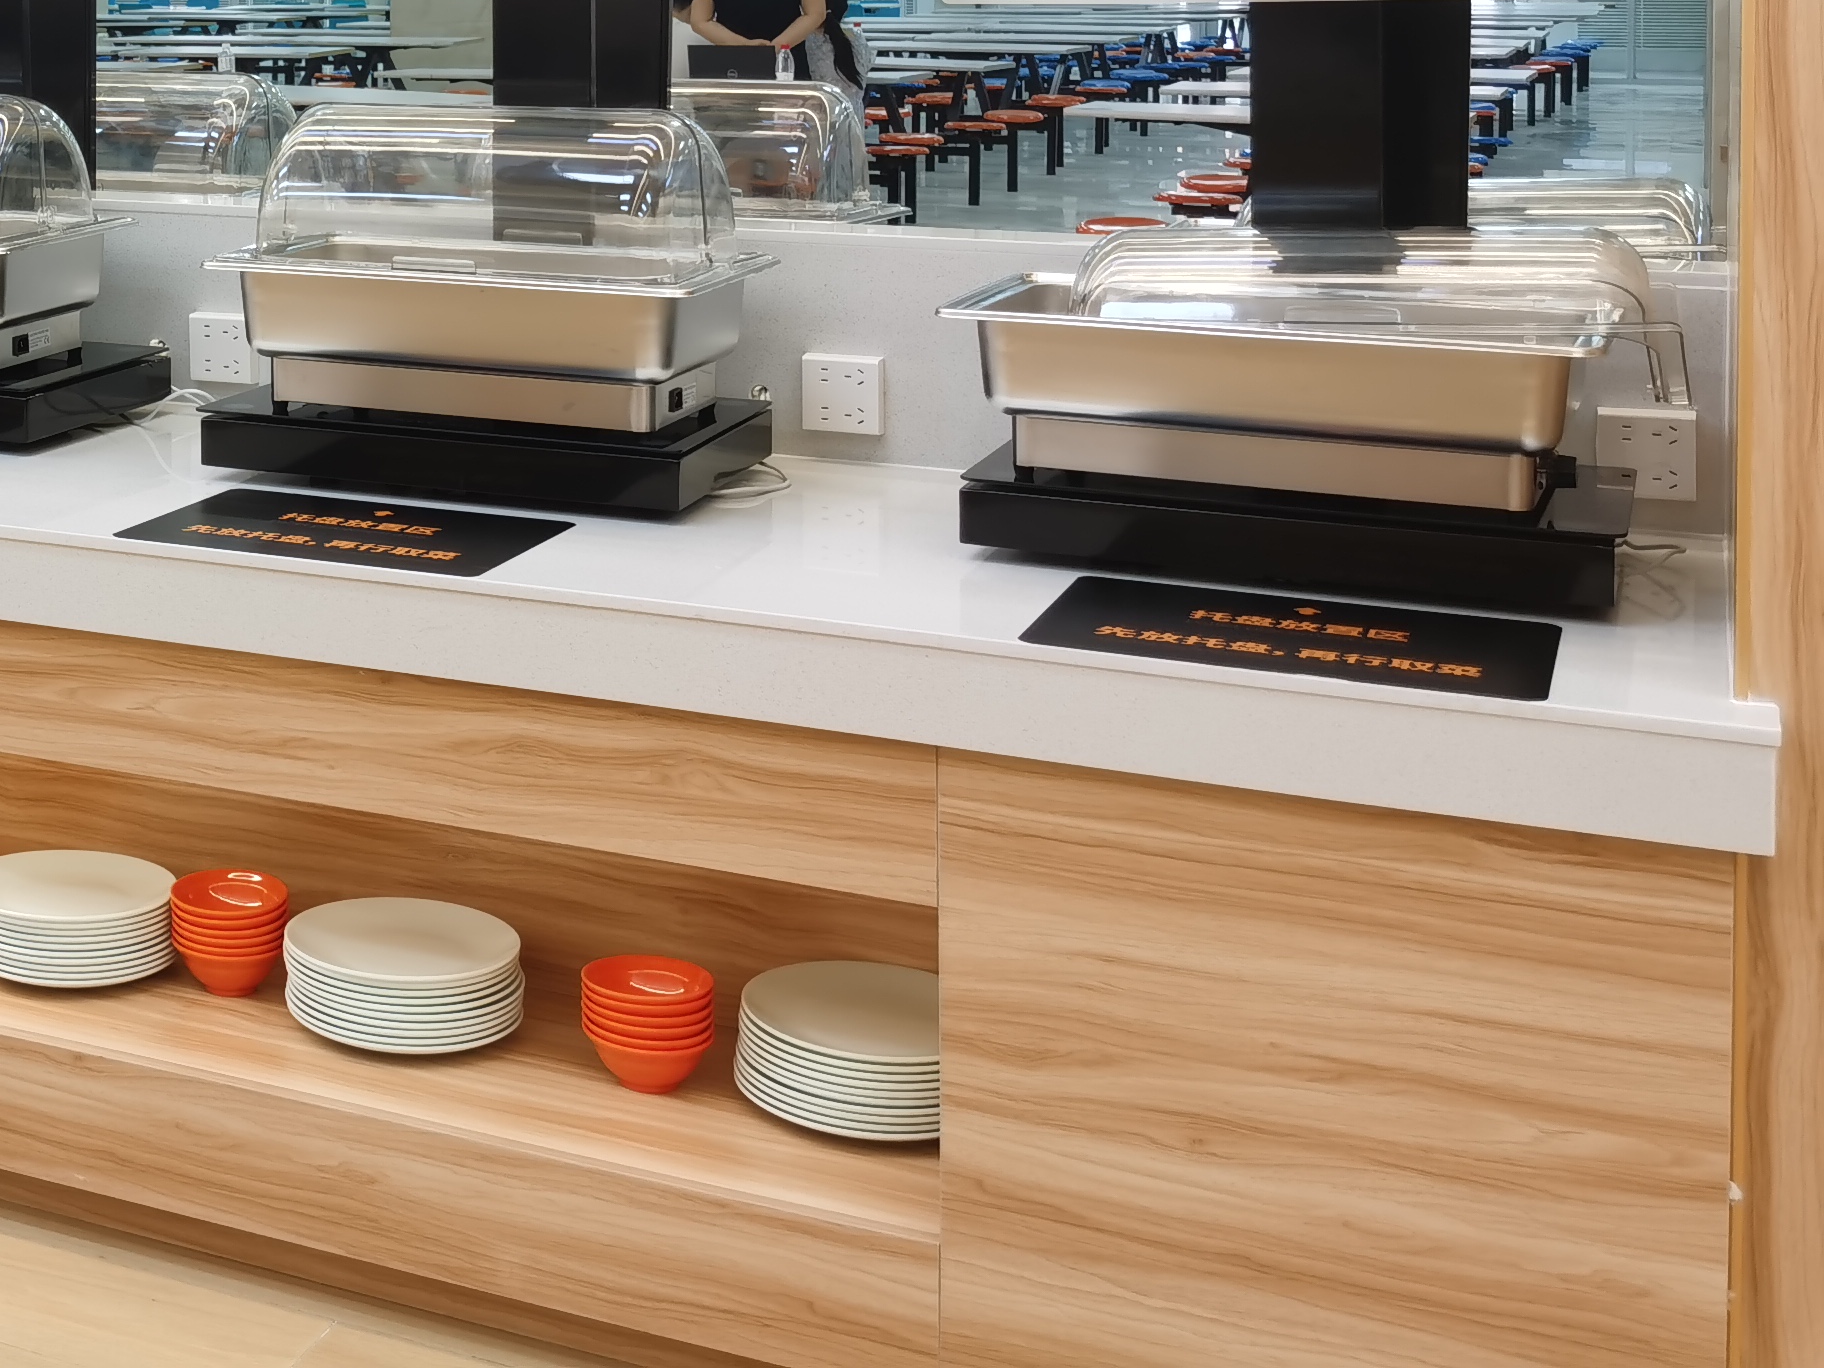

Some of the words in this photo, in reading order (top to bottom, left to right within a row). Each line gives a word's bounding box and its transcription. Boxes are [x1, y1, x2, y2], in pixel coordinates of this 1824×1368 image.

[279, 512, 442, 536] 托盘放置区
[1189, 609, 1411, 643] 托盘放置区
